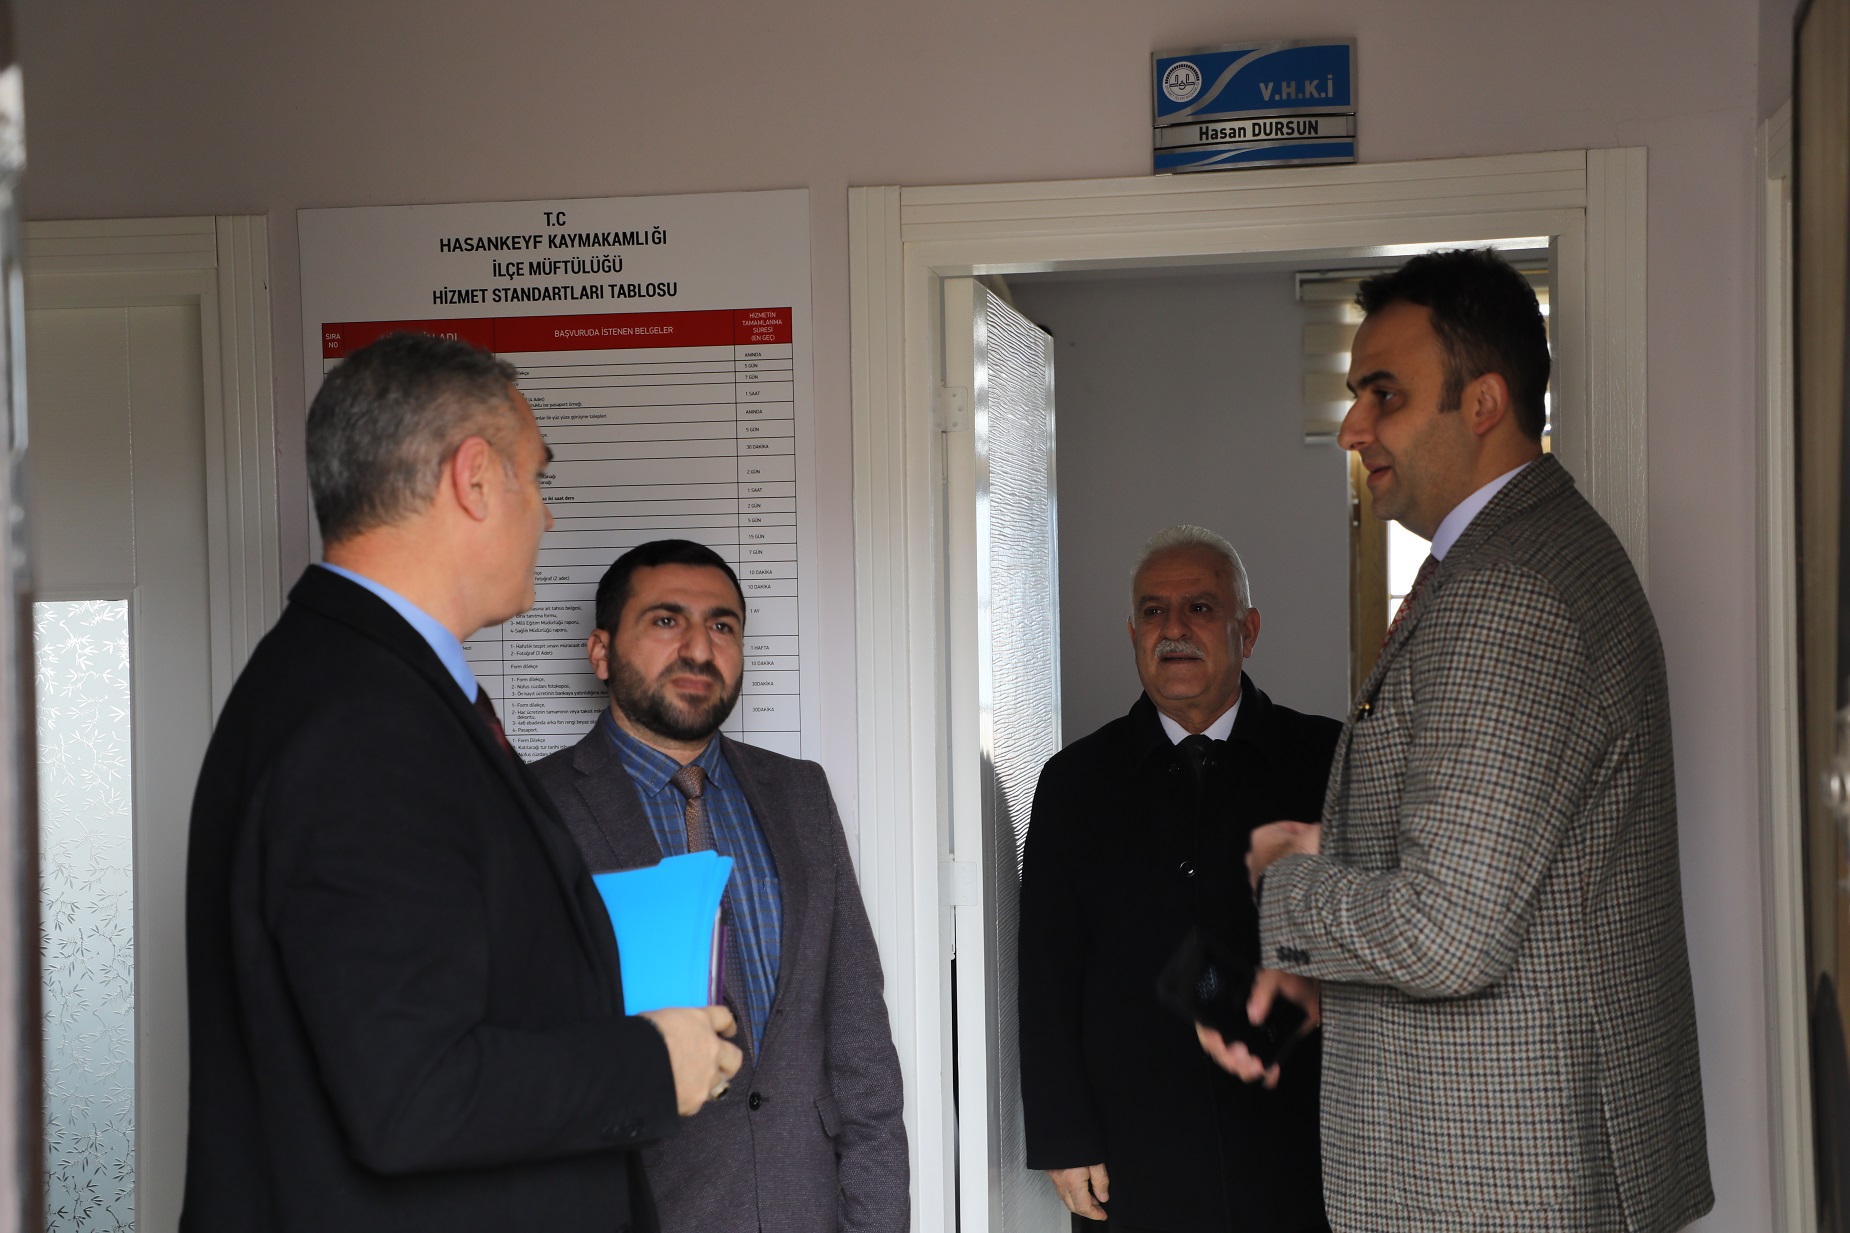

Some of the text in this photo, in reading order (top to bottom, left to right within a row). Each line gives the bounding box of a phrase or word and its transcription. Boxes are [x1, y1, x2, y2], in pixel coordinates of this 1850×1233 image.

[1259, 74, 1333, 101] V.H.K.İ
[1199, 120, 1318, 142] Hasan DURSUN
[544, 211, 566, 227] T.C
[440, 226, 666, 252] HASANKEYF KAYMAKAMLIĞI
[492, 254, 622, 280] İLÇE MÜFTÜLÜĞÜ
[432, 282, 678, 304] HİZMET STANDARTLARI TABLOSU
[554, 326, 674, 338] BAŞVURUDA İSTENEN BELGELER
